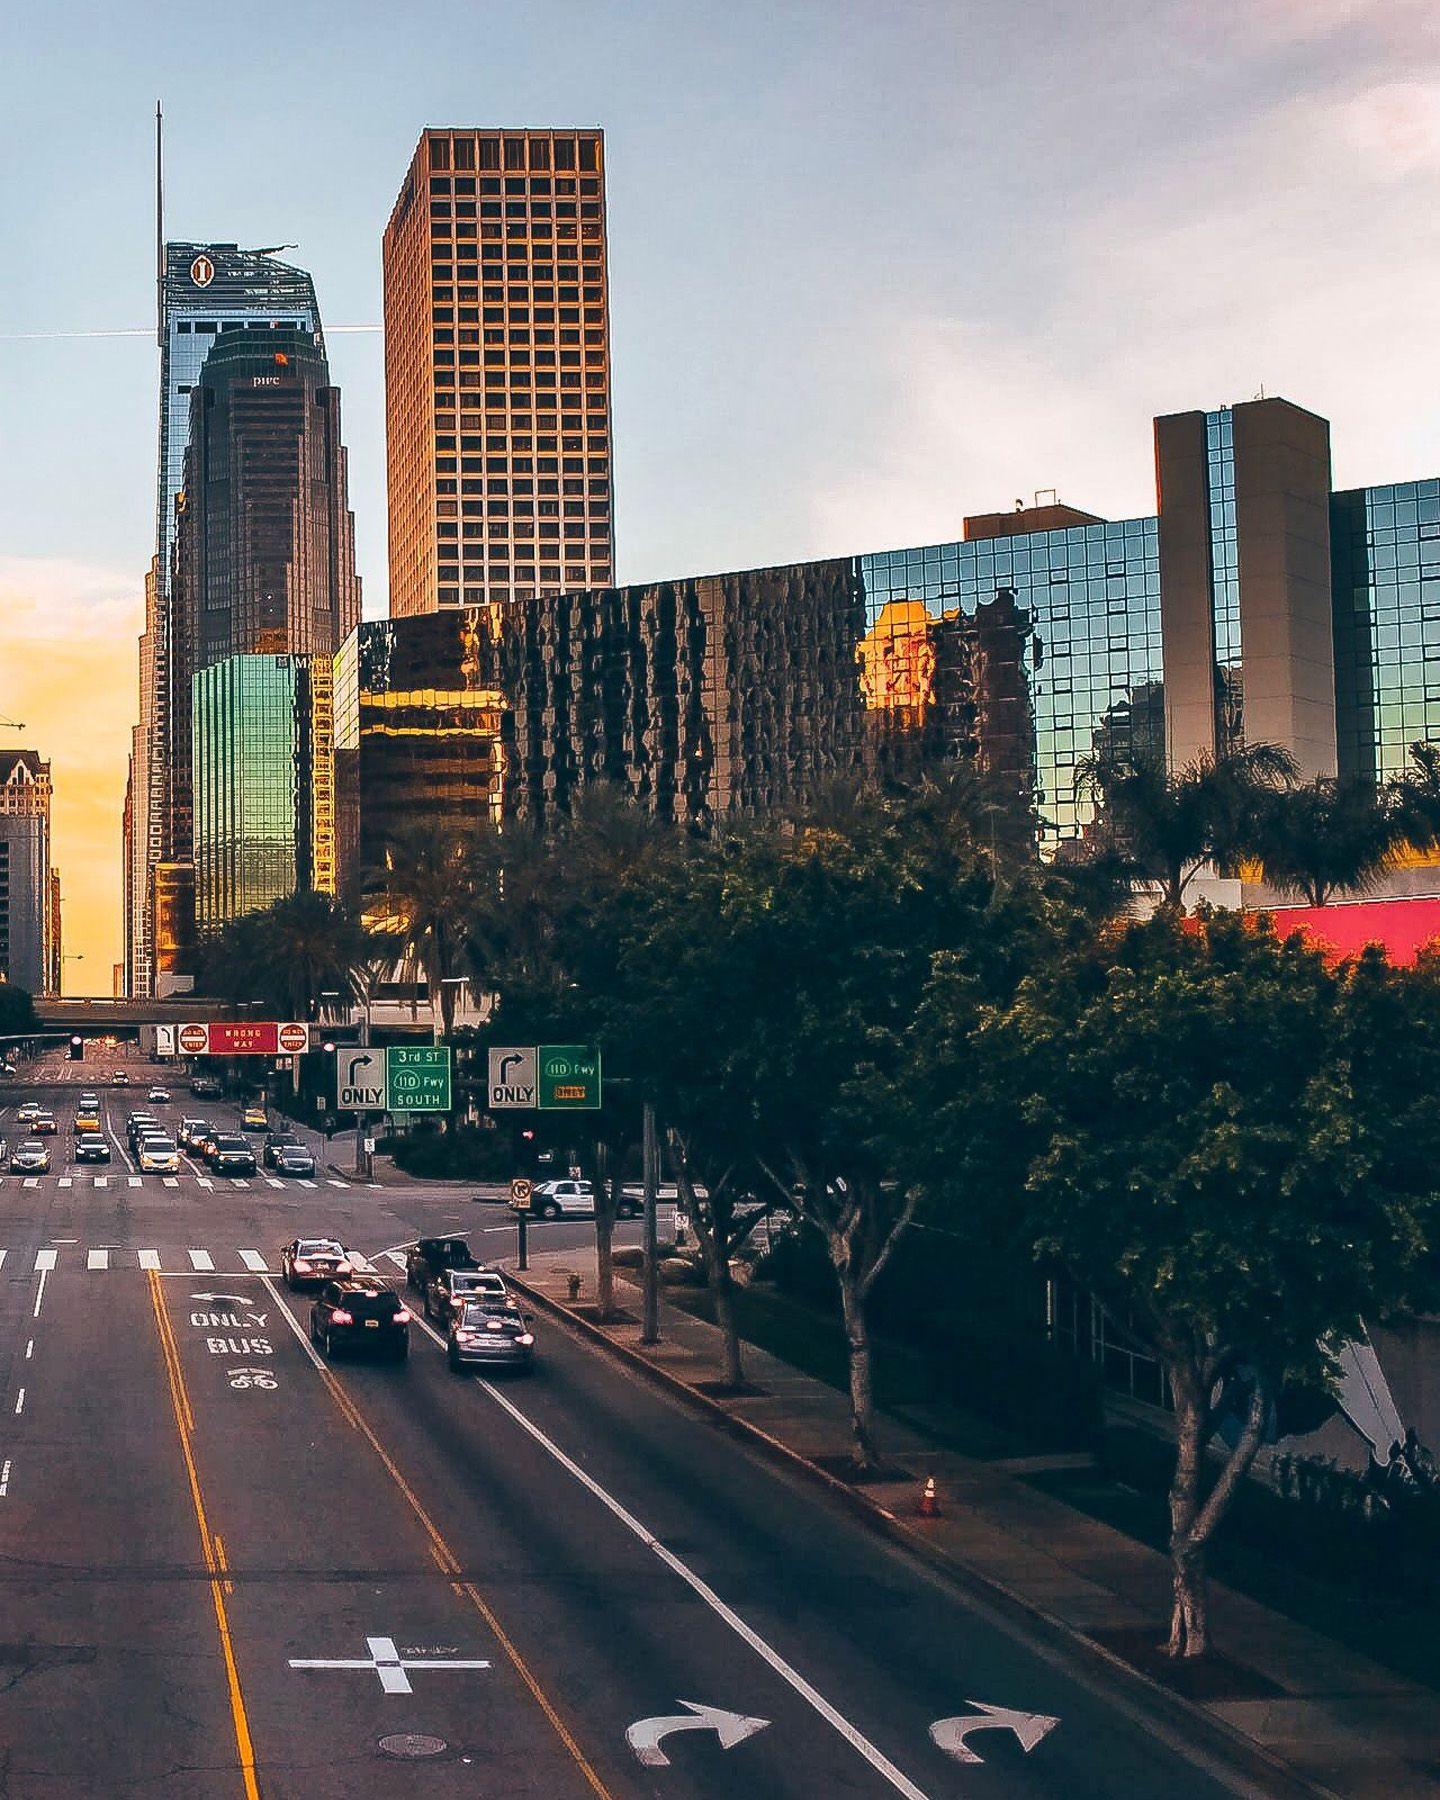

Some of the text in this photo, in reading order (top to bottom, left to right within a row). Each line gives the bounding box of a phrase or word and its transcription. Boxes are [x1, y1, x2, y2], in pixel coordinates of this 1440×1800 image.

[225, 1028, 262, 1038] WRONG
[233, 1040, 254, 1048] WAY
[398, 1051, 440, 1063] 3rd ST
[550, 1064, 595, 1076] 110 Fwy
[399, 1076, 444, 1088] 110 Fwy
[341, 1088, 384, 1104] ONLY
[397, 1094, 440, 1105] SOUTH
[493, 1087, 535, 1102] ONLY
[190, 1312, 269, 1328] ONLY
[206, 1337, 274, 1355] BUS
